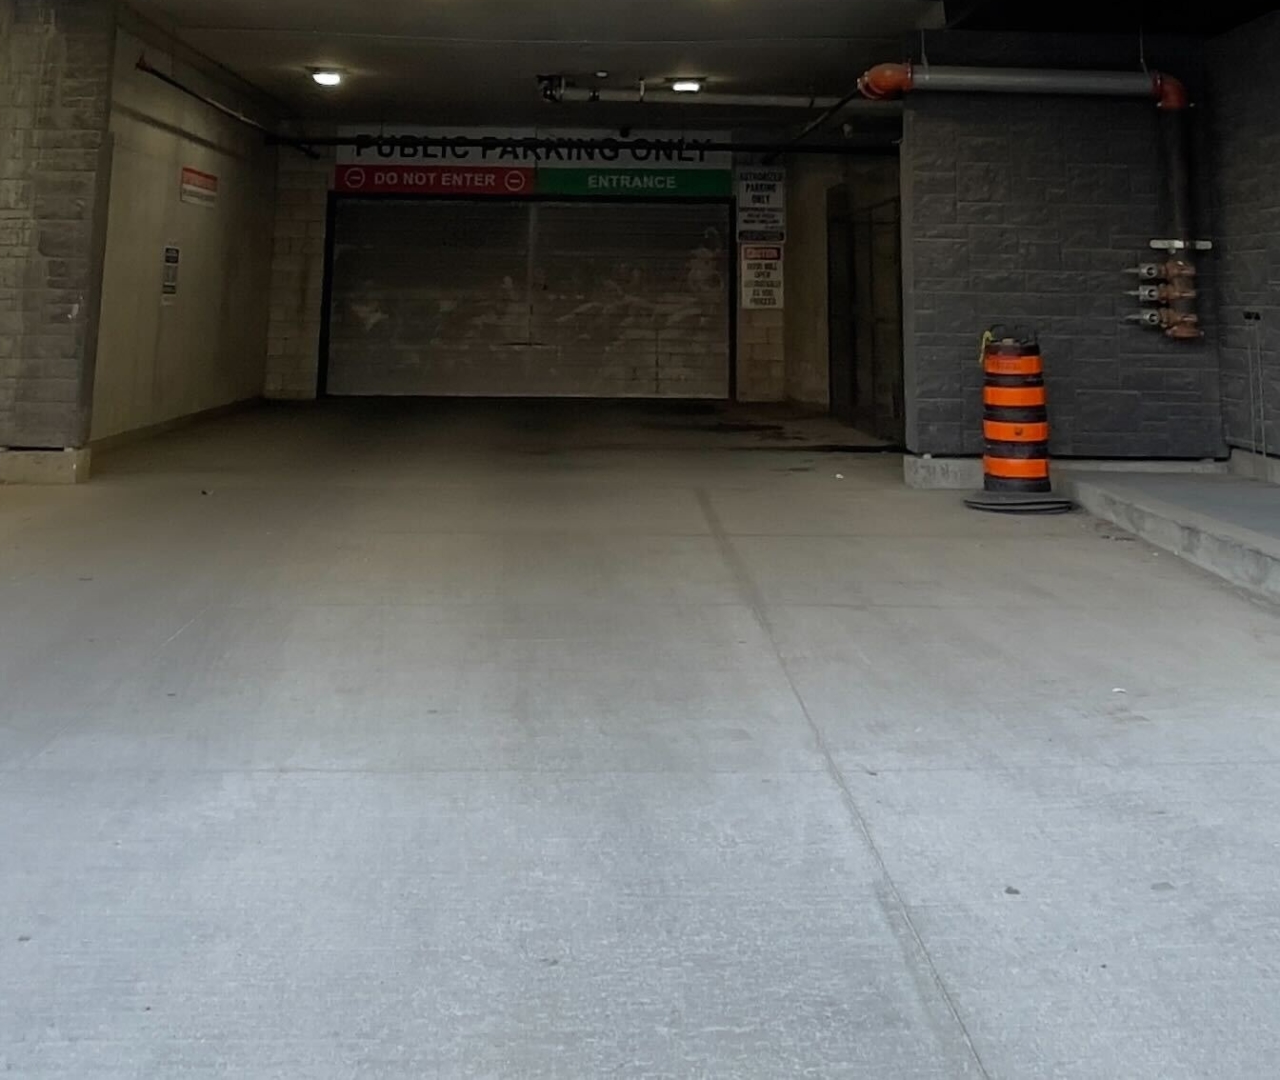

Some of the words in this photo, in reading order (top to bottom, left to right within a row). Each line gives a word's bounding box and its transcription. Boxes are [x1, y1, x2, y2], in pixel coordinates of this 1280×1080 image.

[355, 134, 469, 159] PUBLIC
[482, 136, 619, 161] PARKING
[630, 137, 713, 162] ONLY
[373, 171, 398, 186] DO
[403, 171, 437, 186] NOT
[441, 172, 496, 187] ENTER
[587, 174, 678, 190] ENTRANCE
